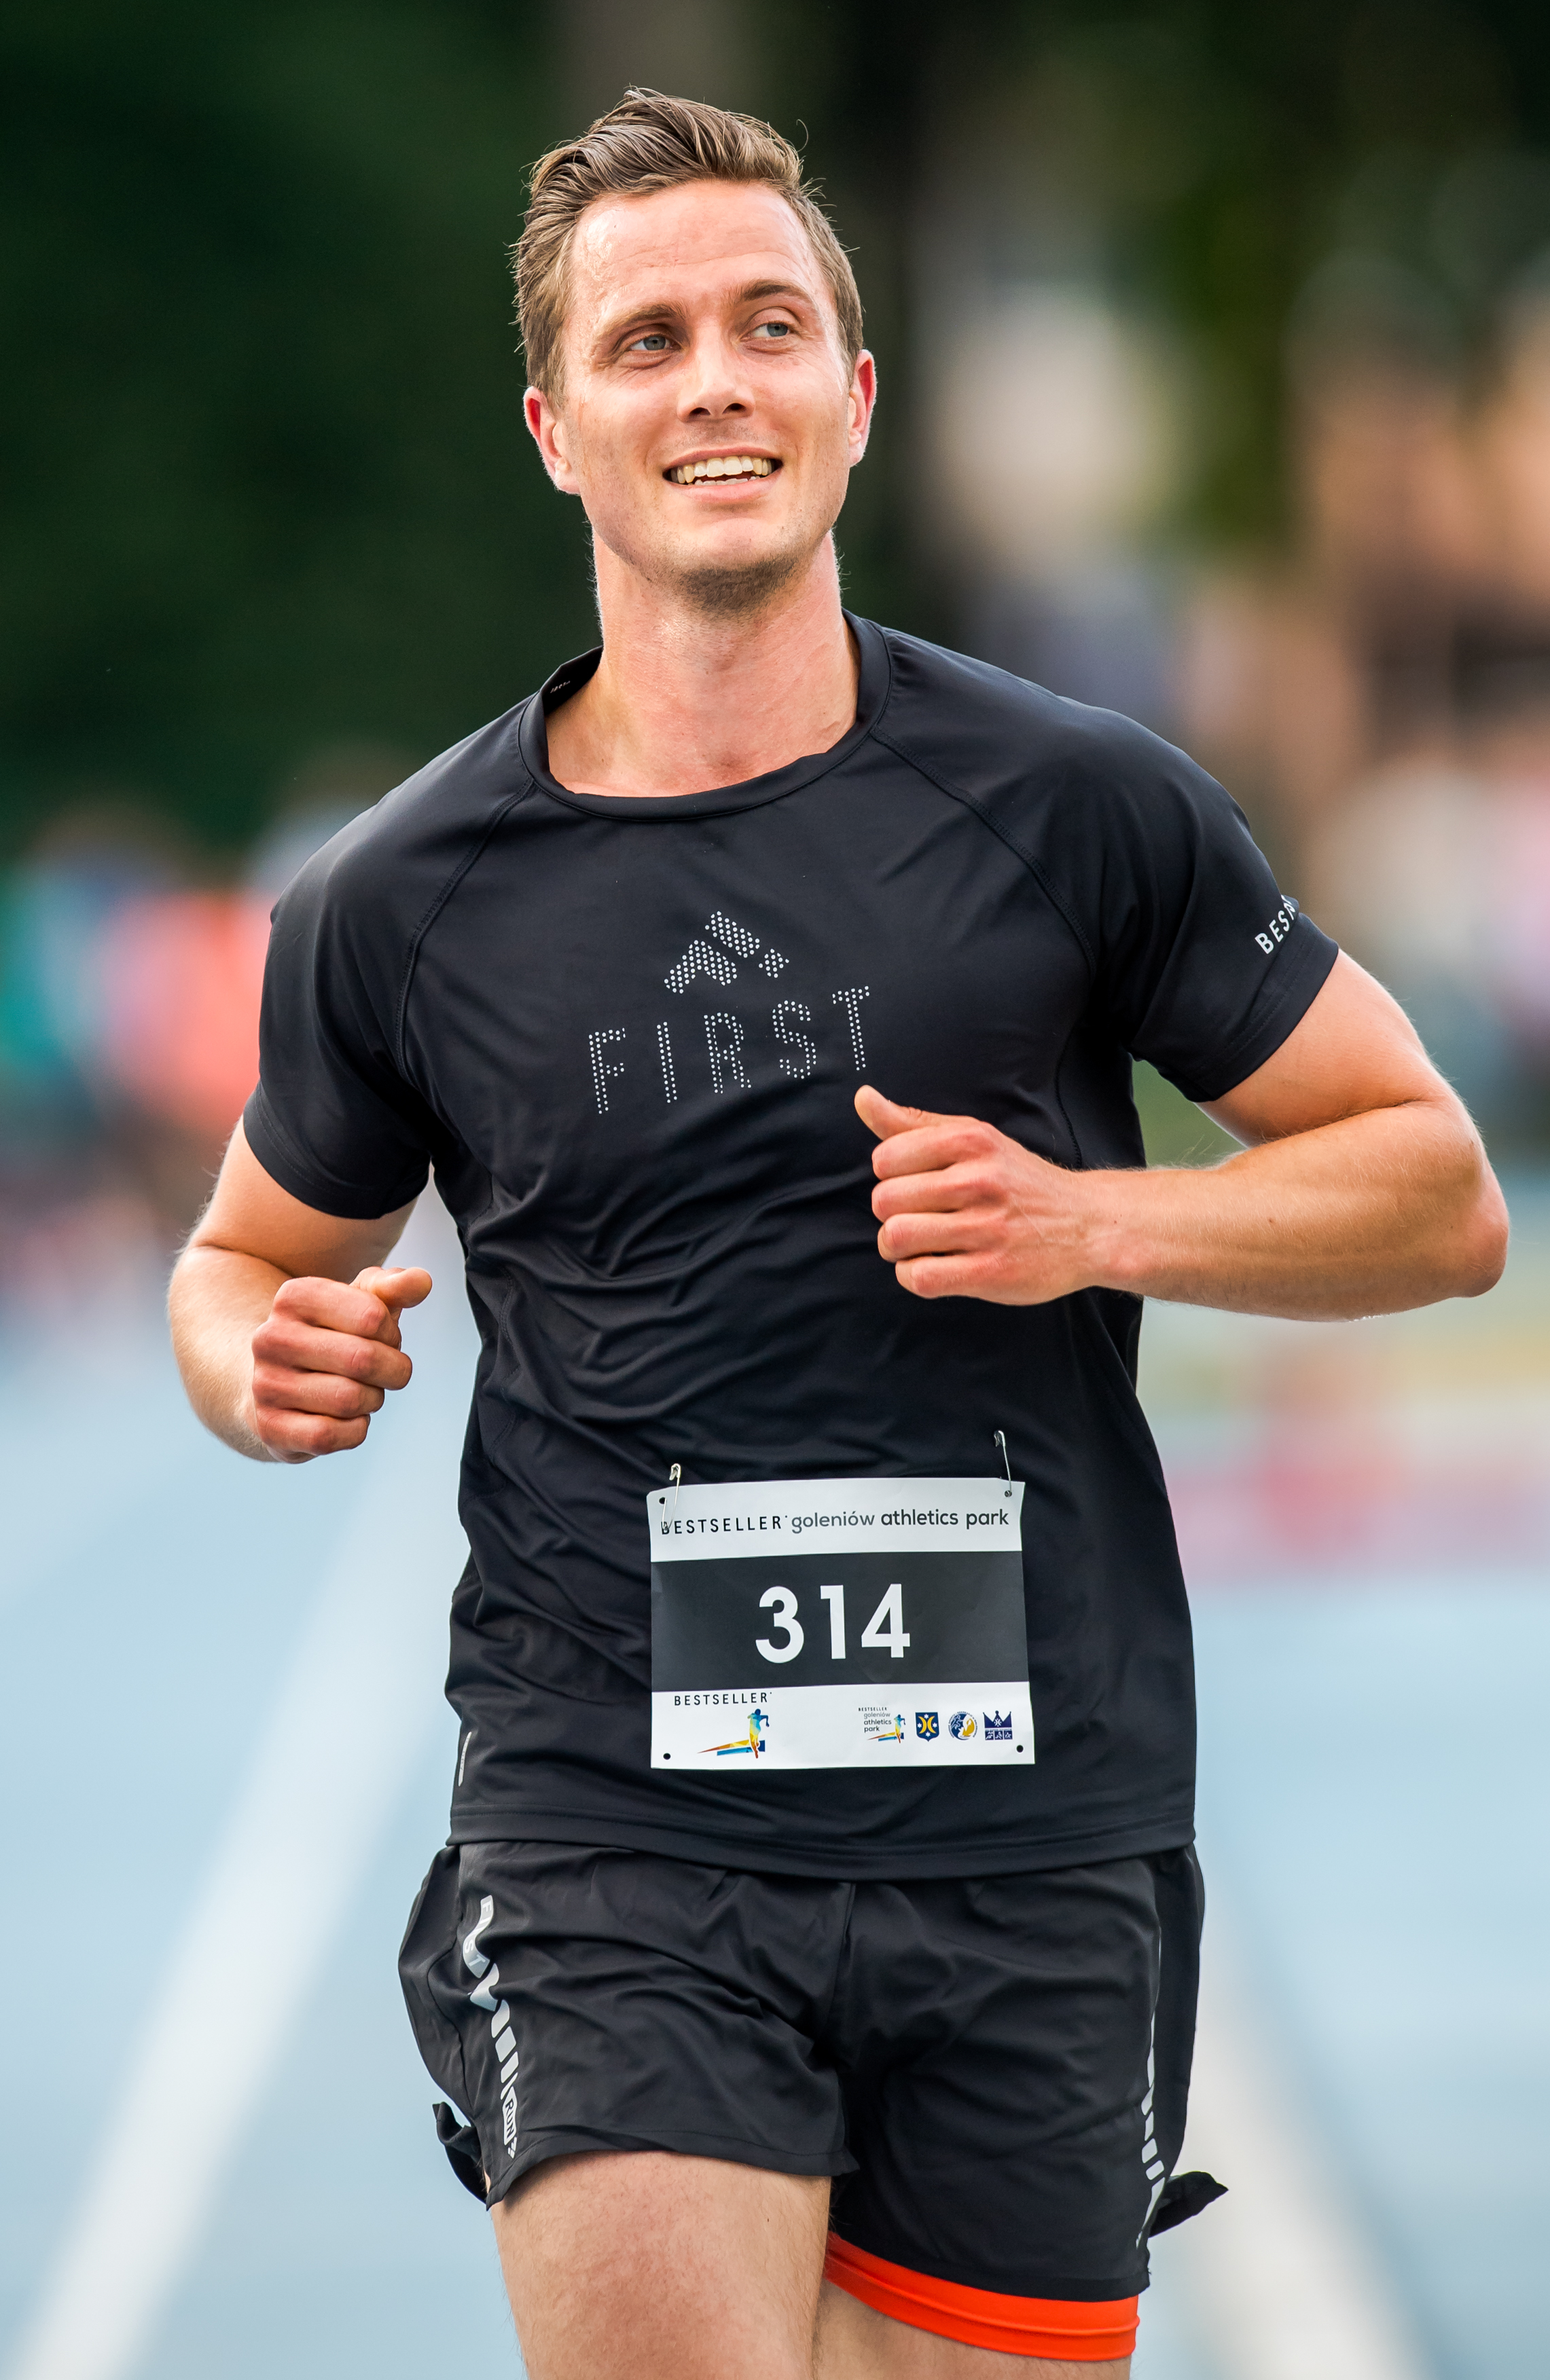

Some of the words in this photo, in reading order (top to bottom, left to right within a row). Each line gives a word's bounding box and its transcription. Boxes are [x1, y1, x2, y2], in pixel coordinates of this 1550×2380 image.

[588, 985, 870, 1114] FIRST
[661, 1515, 782, 1535] BESTSELLER
[791, 1511, 875, 1534] goleniów
[881, 1509, 958, 1526] athletics
[966, 1509, 1009, 1530] park
[755, 1583, 911, 1664] 314
[674, 1692, 768, 1706] BESTSELLER
[864, 1725, 880, 1734] park
[505, 2098, 515, 2140] RUN
